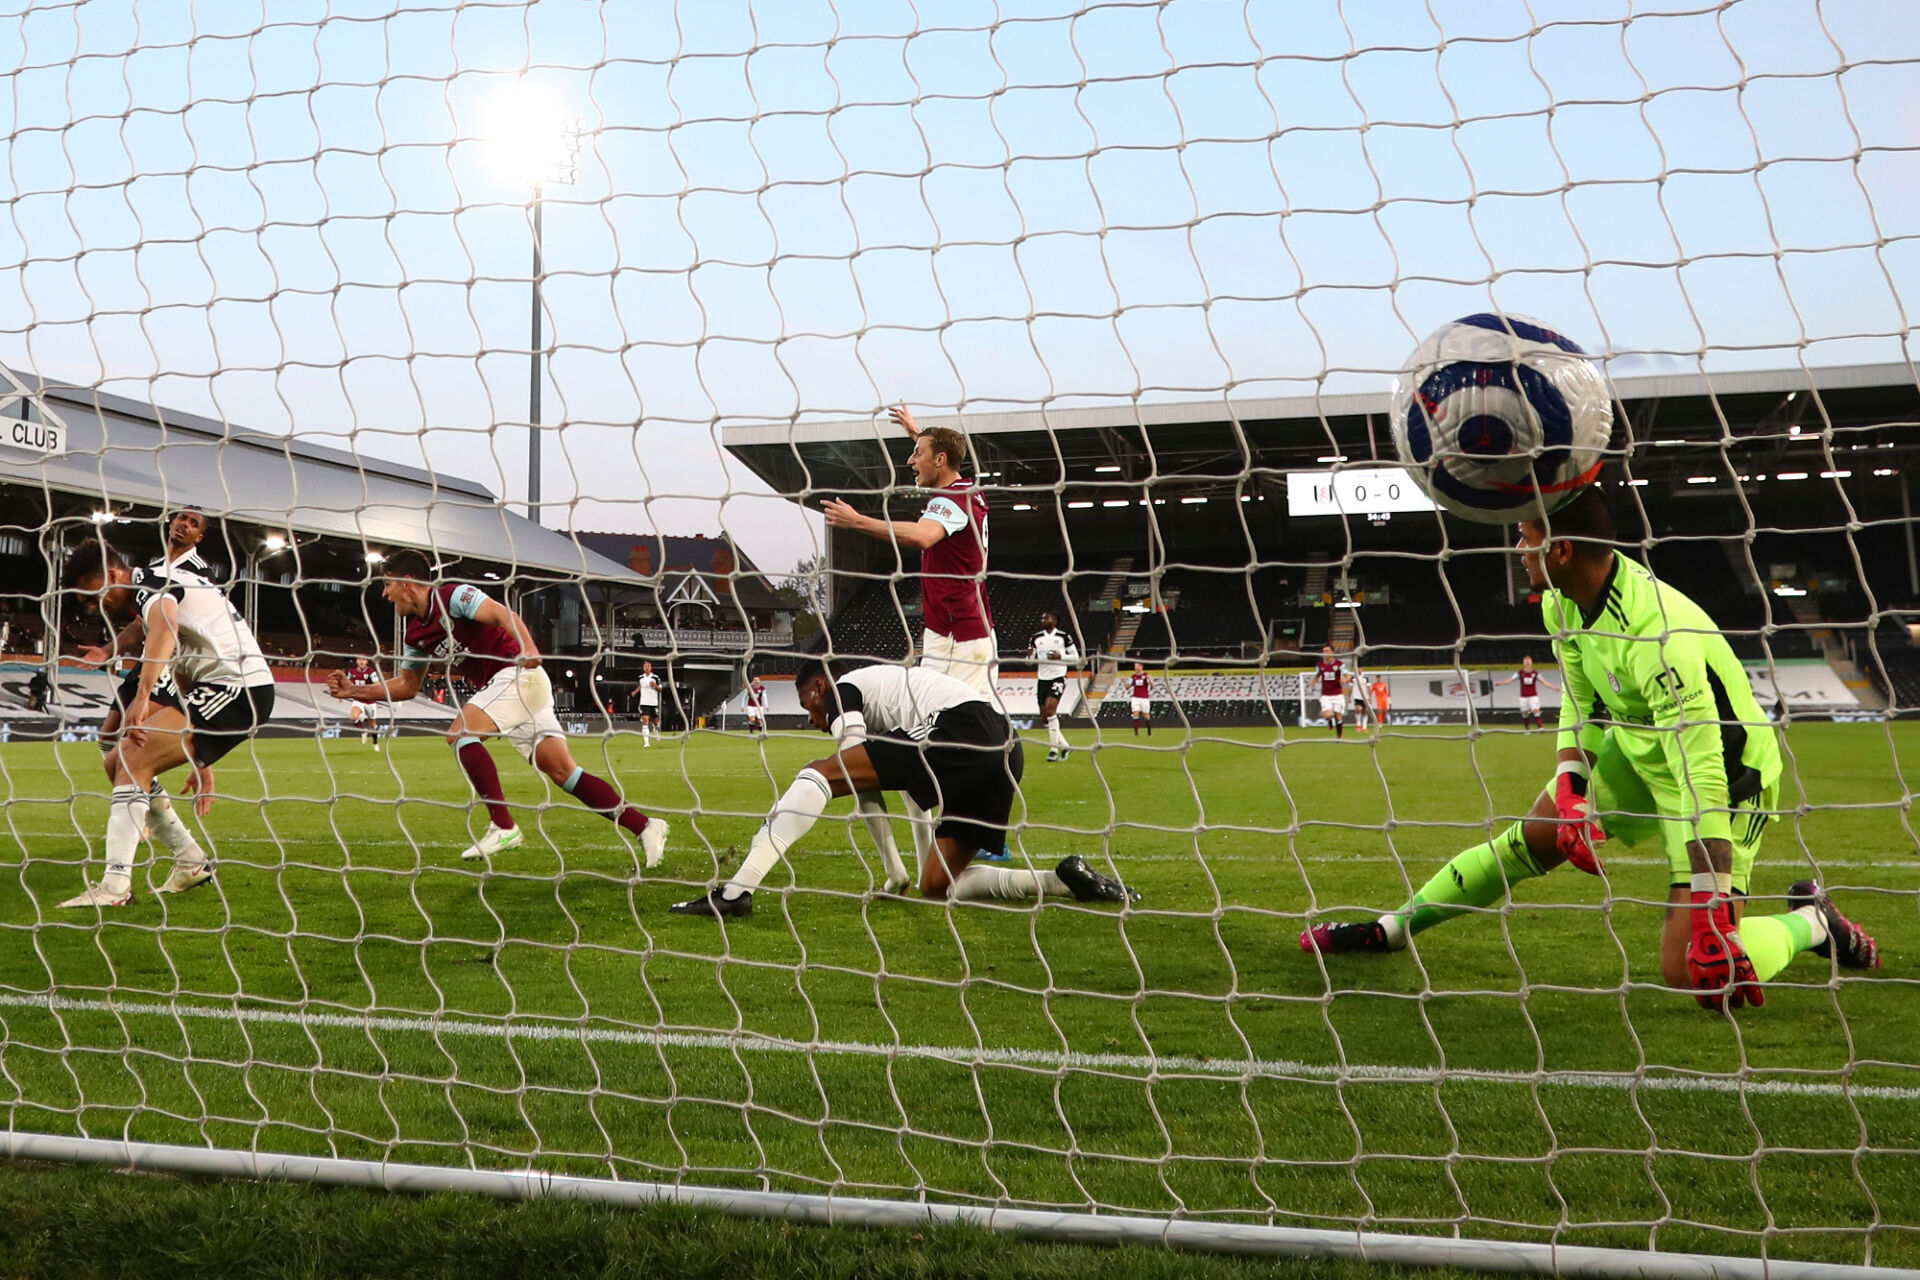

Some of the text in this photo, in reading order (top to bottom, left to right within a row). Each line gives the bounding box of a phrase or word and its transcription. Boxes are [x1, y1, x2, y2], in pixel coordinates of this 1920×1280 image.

[12, 423, 58, 450] CLUB
[1355, 485, 1367, 502] 0
[1388, 484, 1400, 500] 0
